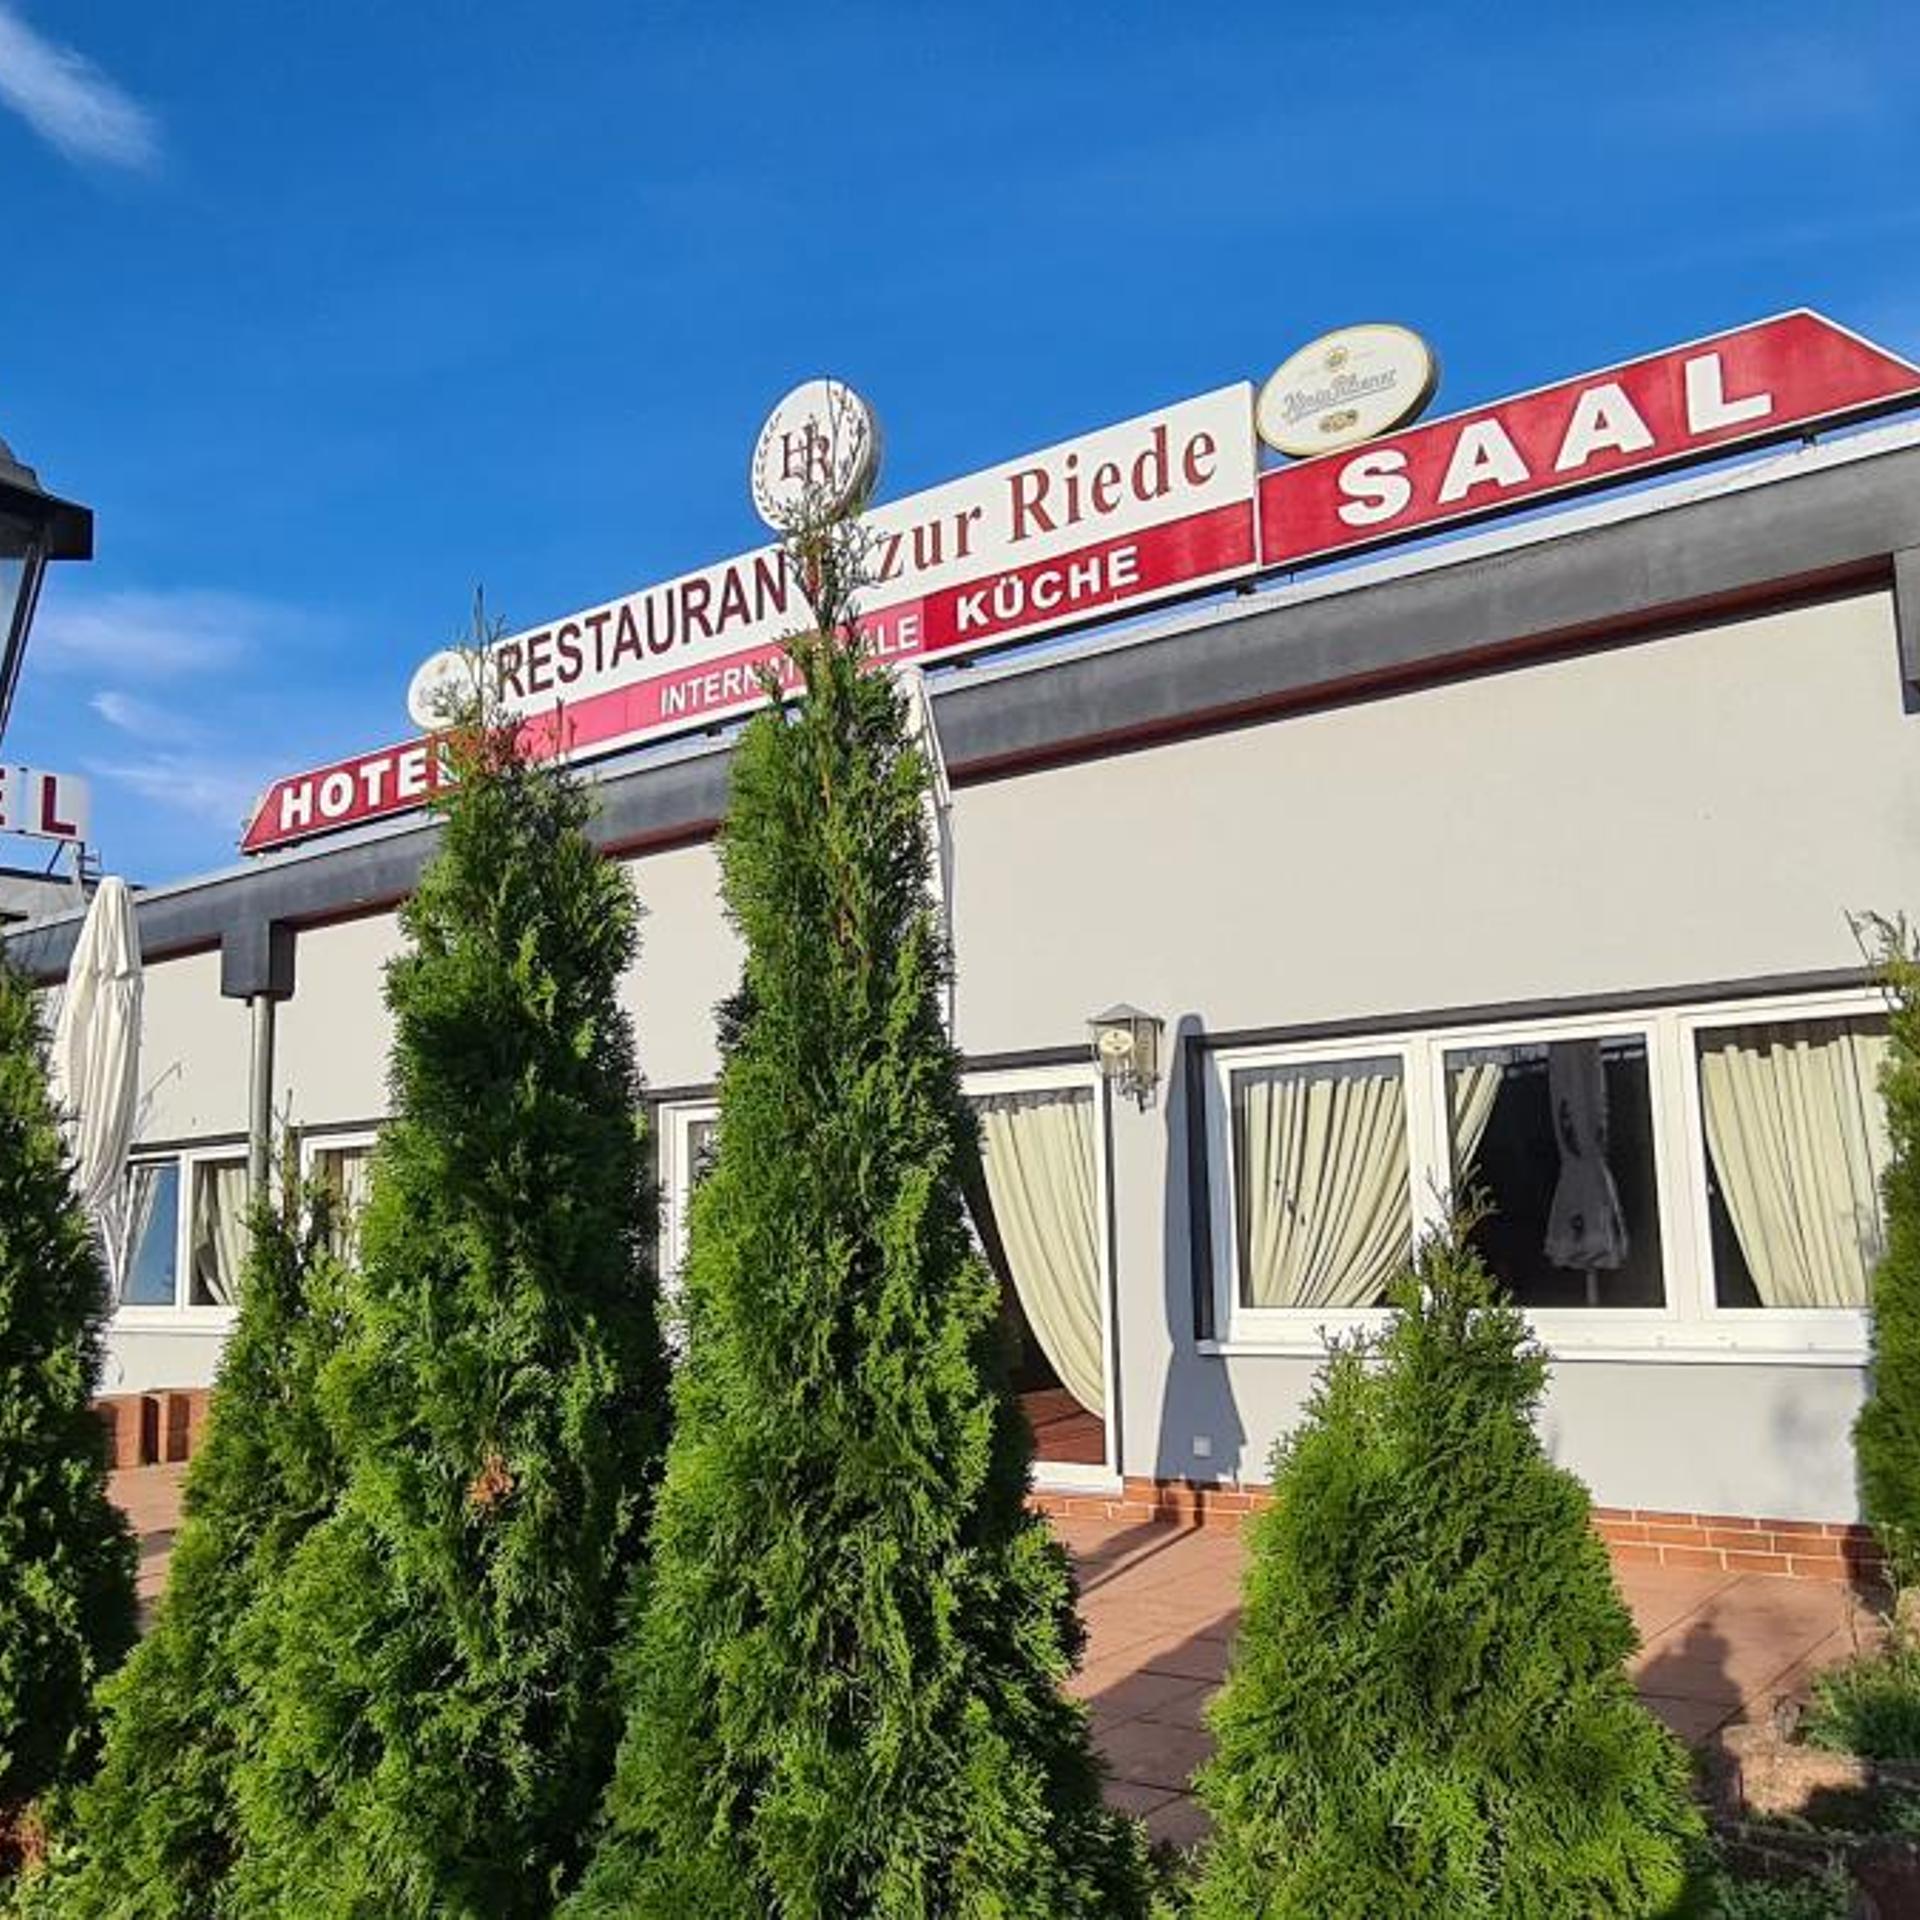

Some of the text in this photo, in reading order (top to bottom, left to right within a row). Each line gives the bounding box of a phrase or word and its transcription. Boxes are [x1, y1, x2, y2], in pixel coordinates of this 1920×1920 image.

[1337, 352, 1772, 527] SAAL
[497, 424, 1217, 704] RESTAURAN zur Riede
[660, 545, 1139, 718] INTERNTALE KÜCHE
